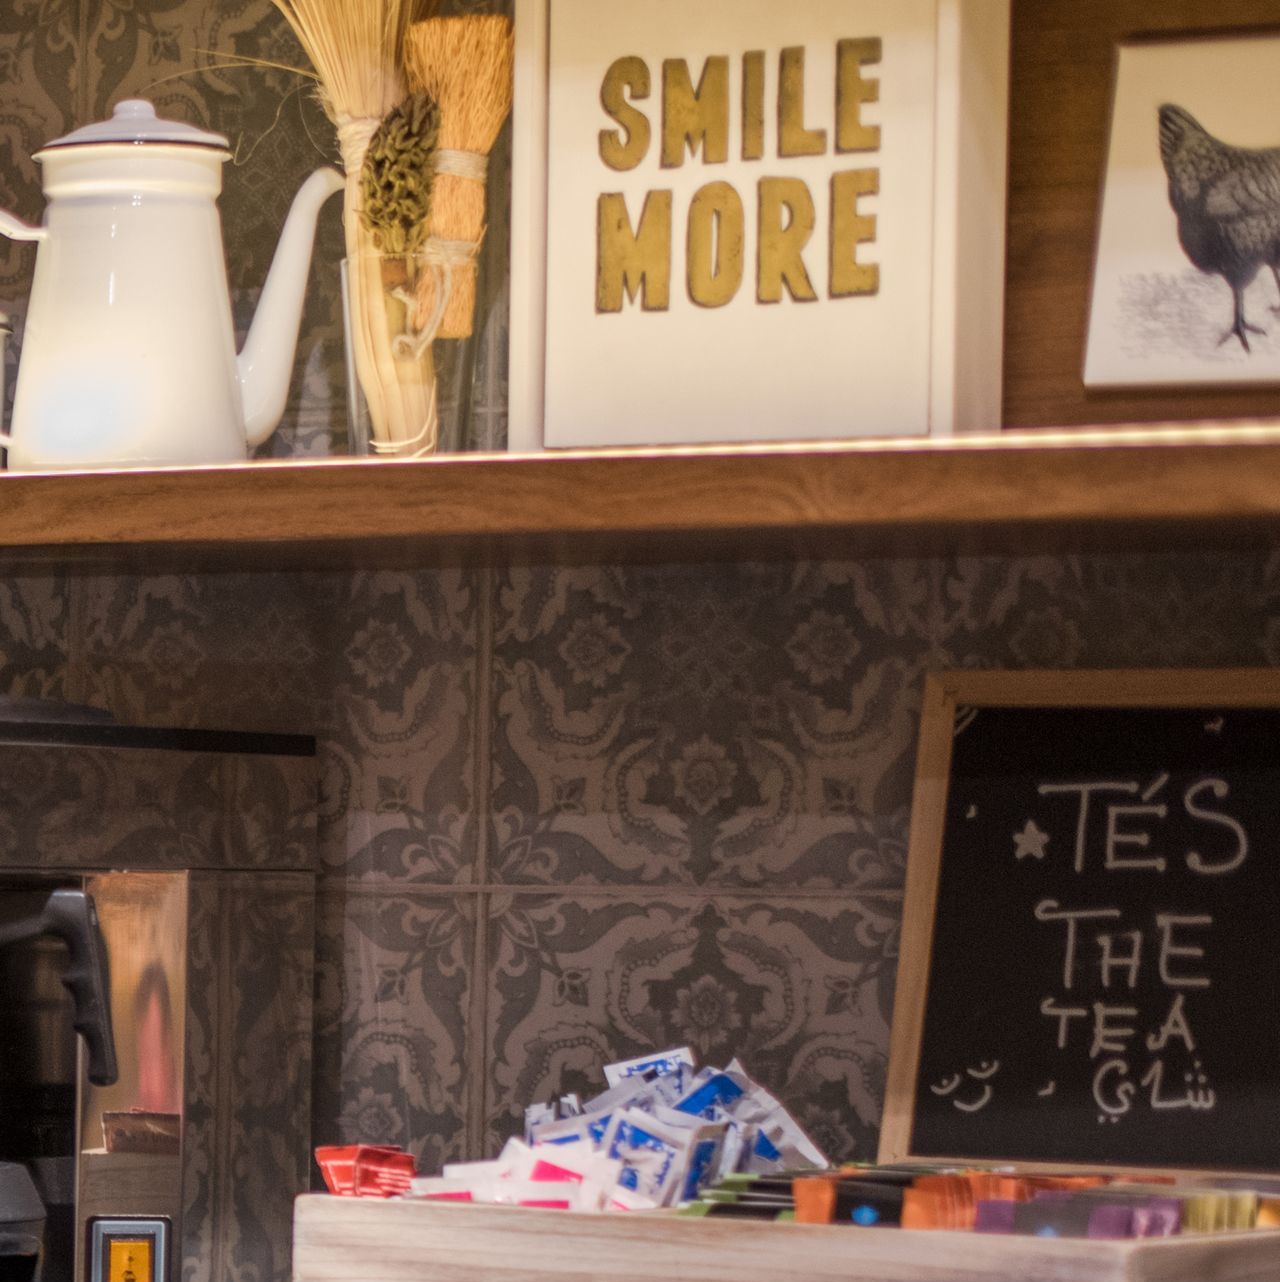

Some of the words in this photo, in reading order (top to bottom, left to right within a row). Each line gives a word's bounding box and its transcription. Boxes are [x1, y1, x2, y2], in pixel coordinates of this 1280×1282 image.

[597, 36, 882, 172] SMILE
[595, 166, 880, 314] MORE
[1037, 773, 1249, 874] TÉS
[1034, 899, 1214, 989] THE
[1041, 994, 1195, 1058] TEA
